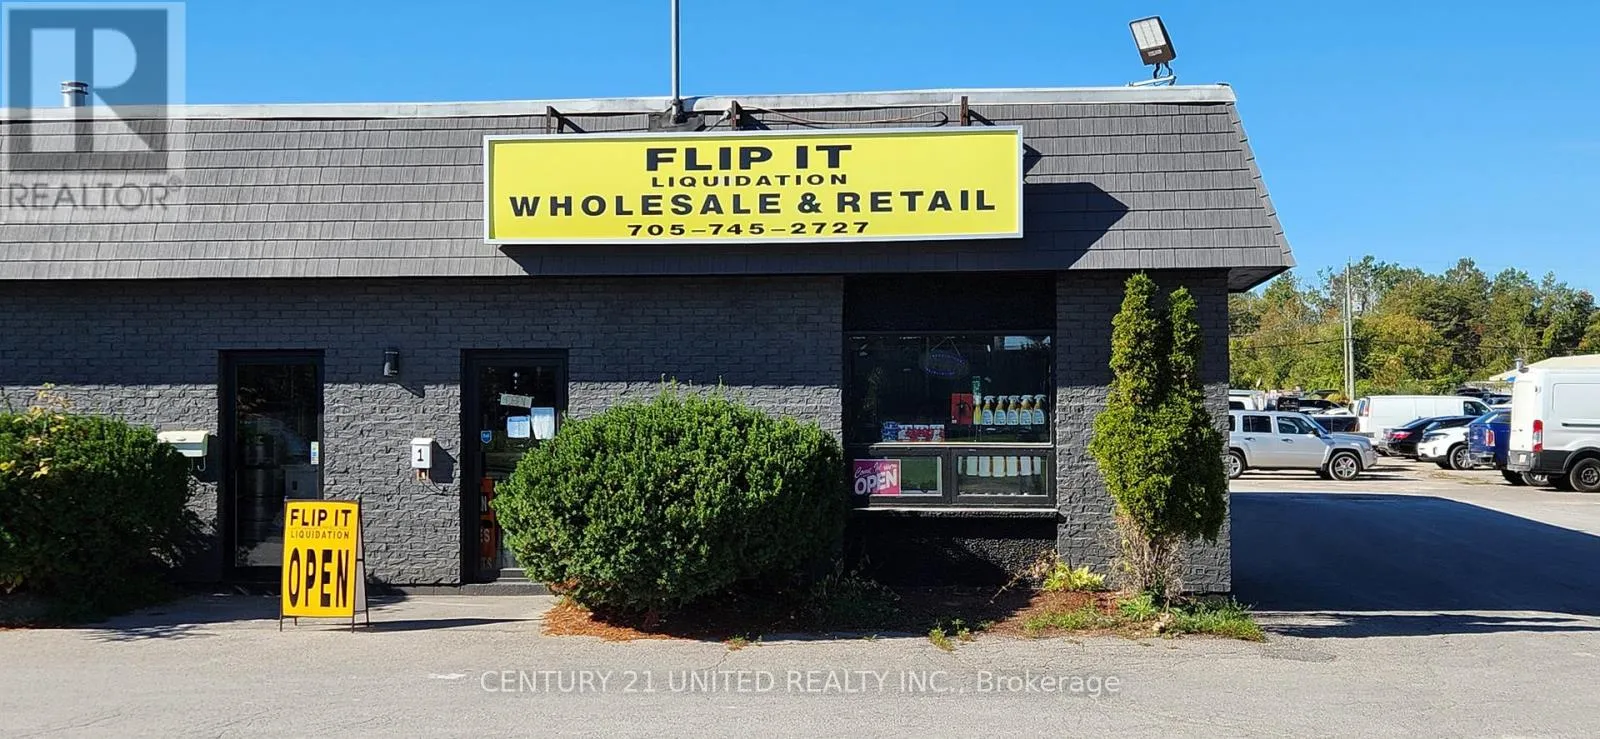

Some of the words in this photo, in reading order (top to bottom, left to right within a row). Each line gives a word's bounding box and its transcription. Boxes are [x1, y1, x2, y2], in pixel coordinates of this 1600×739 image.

[647, 146, 773, 171] FLIP
[796, 145, 852, 169] IT
[652, 174, 847, 188] LIQUIDATION
[509, 193, 781, 217] WHOLESALE
[797, 192, 822, 214] &
[837, 190, 996, 213] RETAIL
[627, 222, 869, 237] 705-745-2727
[416, 448, 424, 462] 1
[854, 468, 898, 495] OPEN
[290, 508, 328, 526] FLIP
[334, 509, 352, 527] IT
[291, 530, 350, 540] LIQUIDATION
[288, 547, 350, 608] OPEN
